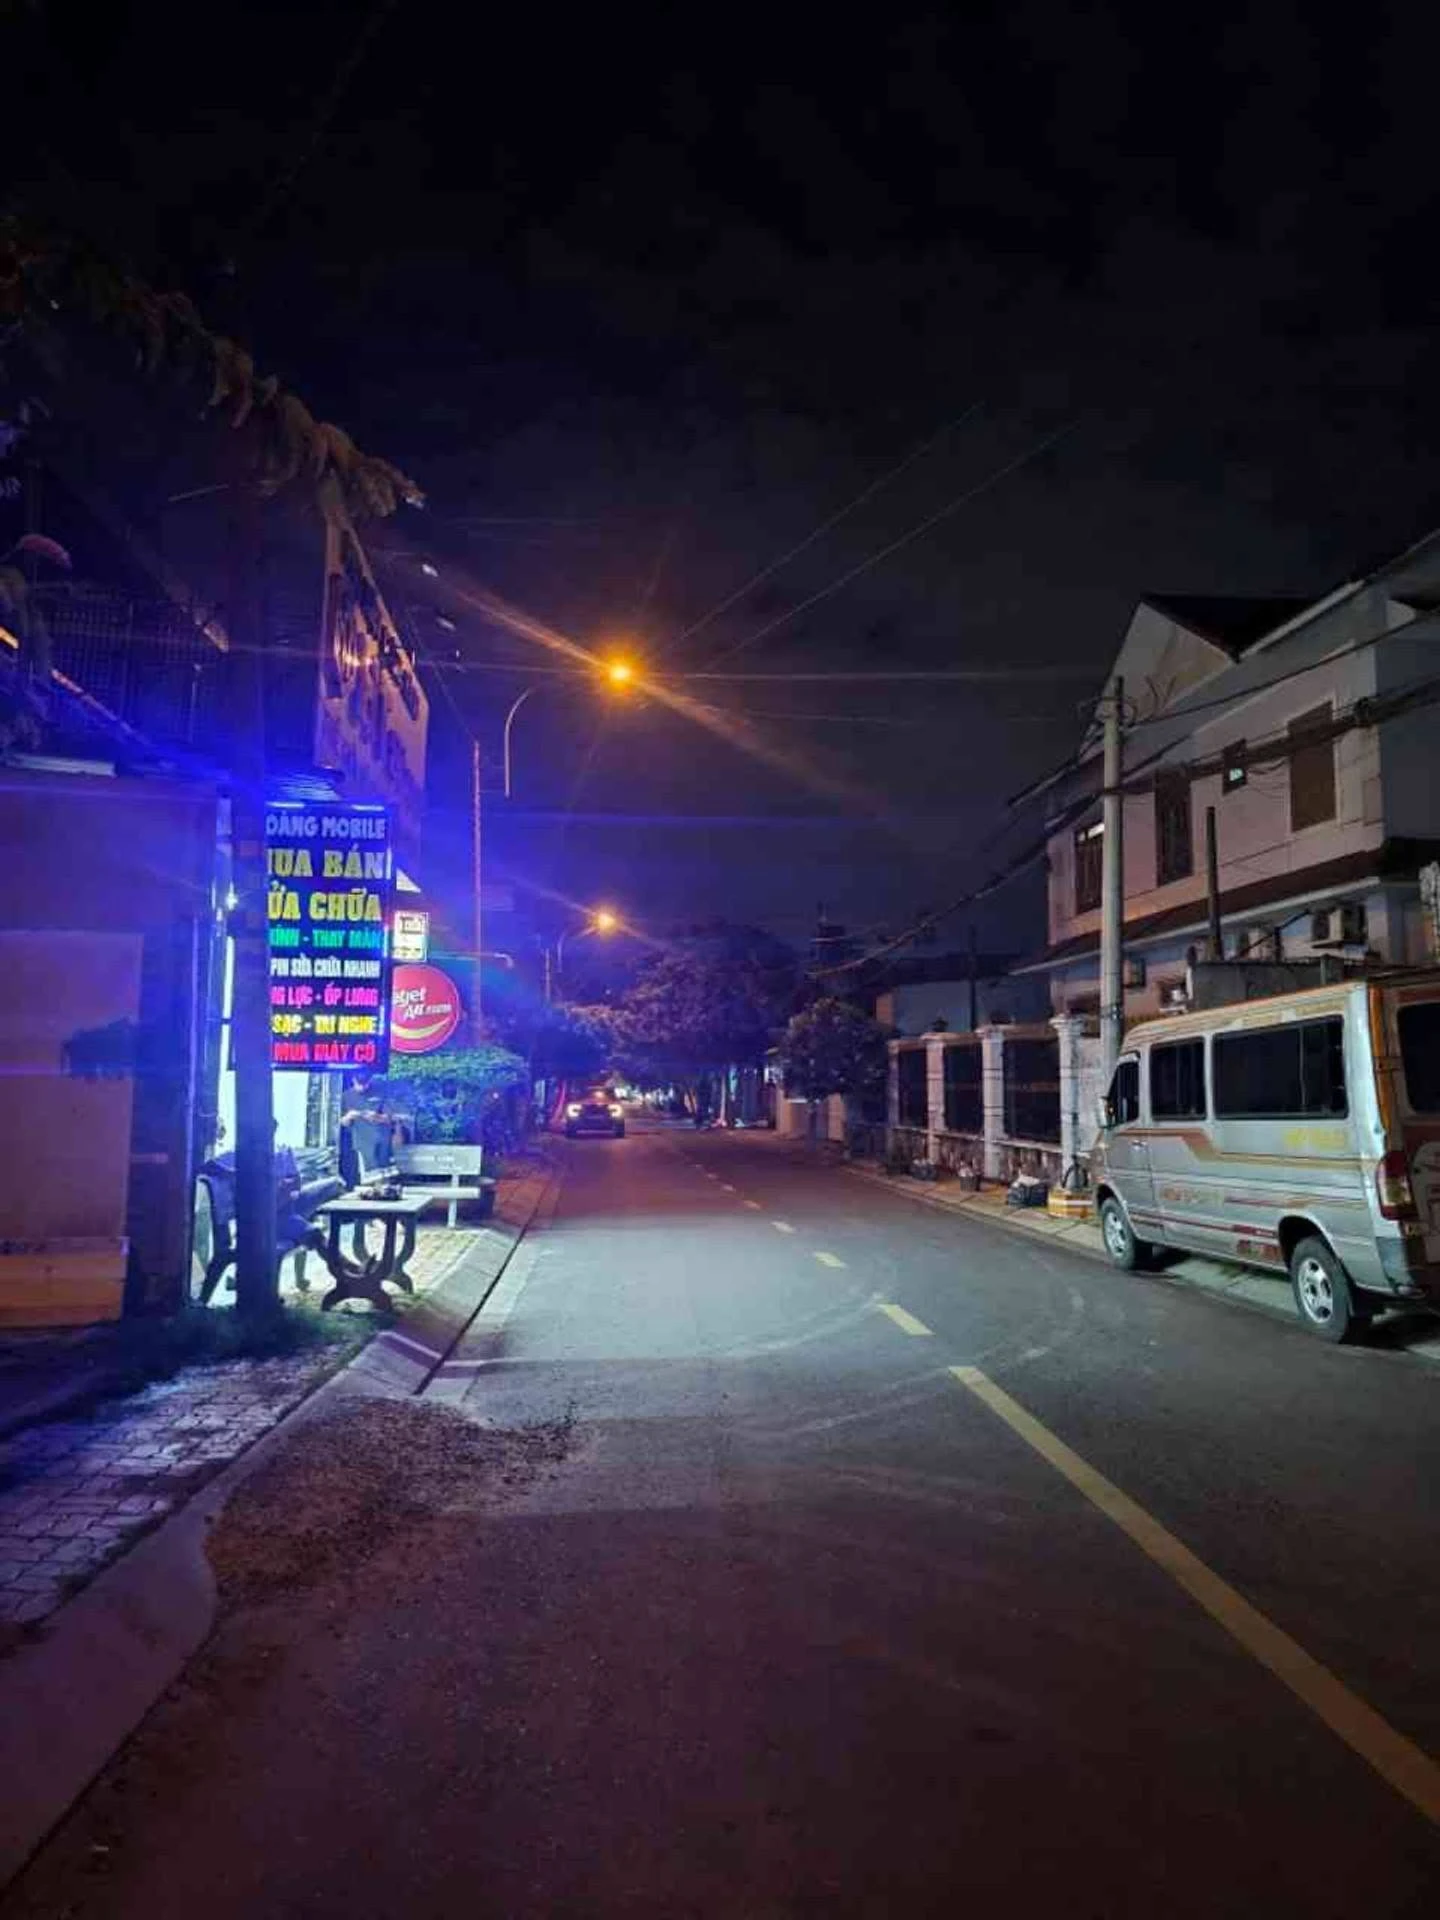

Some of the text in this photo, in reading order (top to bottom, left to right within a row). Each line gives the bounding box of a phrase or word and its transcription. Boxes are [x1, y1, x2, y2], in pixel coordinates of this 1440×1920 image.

[321, 816, 386, 839] MOBILE
[268, 843, 385, 879] UA BÁN
[309, 888, 382, 921] CHỮA
[287, 985, 313, 1009] LỰC
[324, 981, 342, 1006] ỐP
[272, 1014, 302, 1037] SẠC
[338, 1015, 378, 1035] NGHE
[314, 1040, 350, 1062] MÁY
